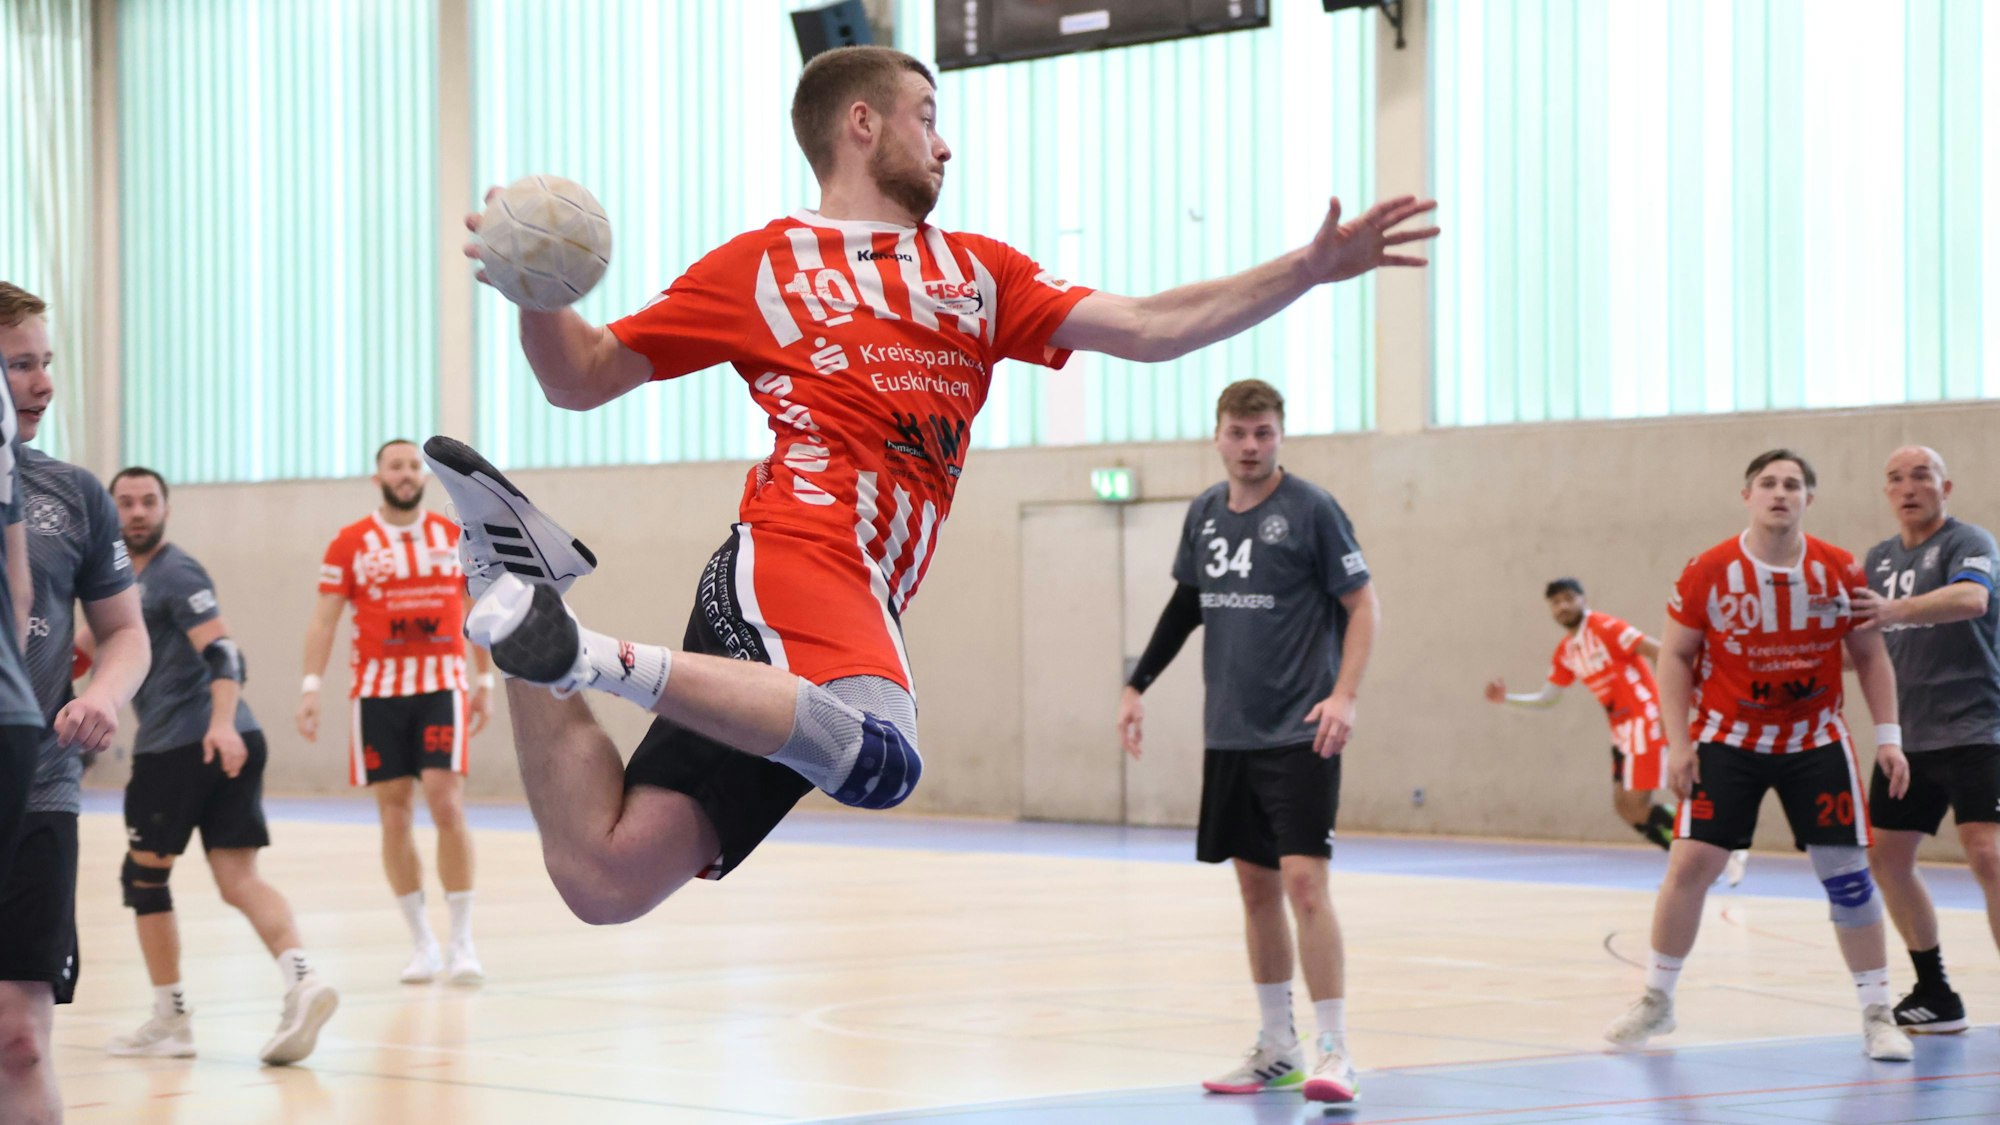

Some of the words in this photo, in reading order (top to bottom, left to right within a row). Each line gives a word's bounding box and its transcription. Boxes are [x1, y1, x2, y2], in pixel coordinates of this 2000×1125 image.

[785, 268, 859, 321] 10
[925, 281, 976, 299] HSG
[859, 342, 986, 376] Kreissparka
[871, 370, 971, 398] Euskirchen
[1205, 537, 1253, 578] 34
[1883, 569, 1916, 600] 19
[1719, 593, 1761, 629] 20
[1815, 790, 1855, 827] 20
